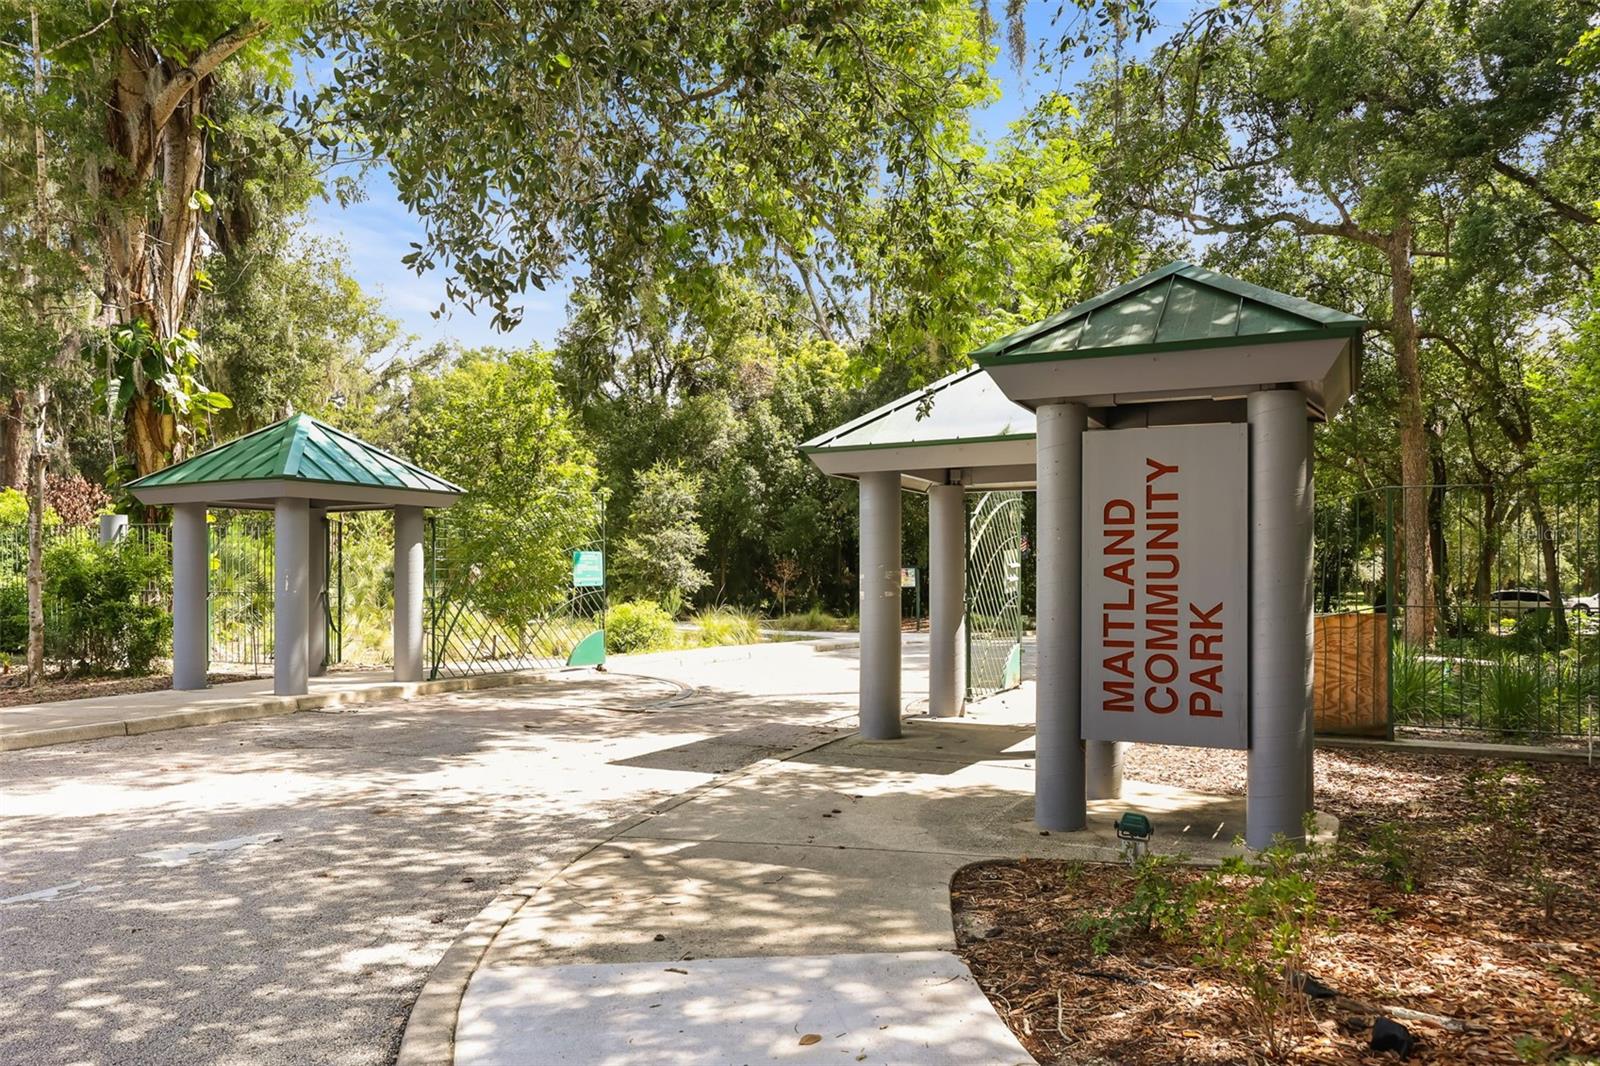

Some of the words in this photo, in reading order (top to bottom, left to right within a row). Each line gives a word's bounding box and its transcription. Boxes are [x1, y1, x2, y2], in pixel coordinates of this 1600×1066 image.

[1103, 498, 1136, 712] MAITLAND
[1144, 458, 1180, 714] COMMUNITY
[1189, 602, 1223, 717] PARK
